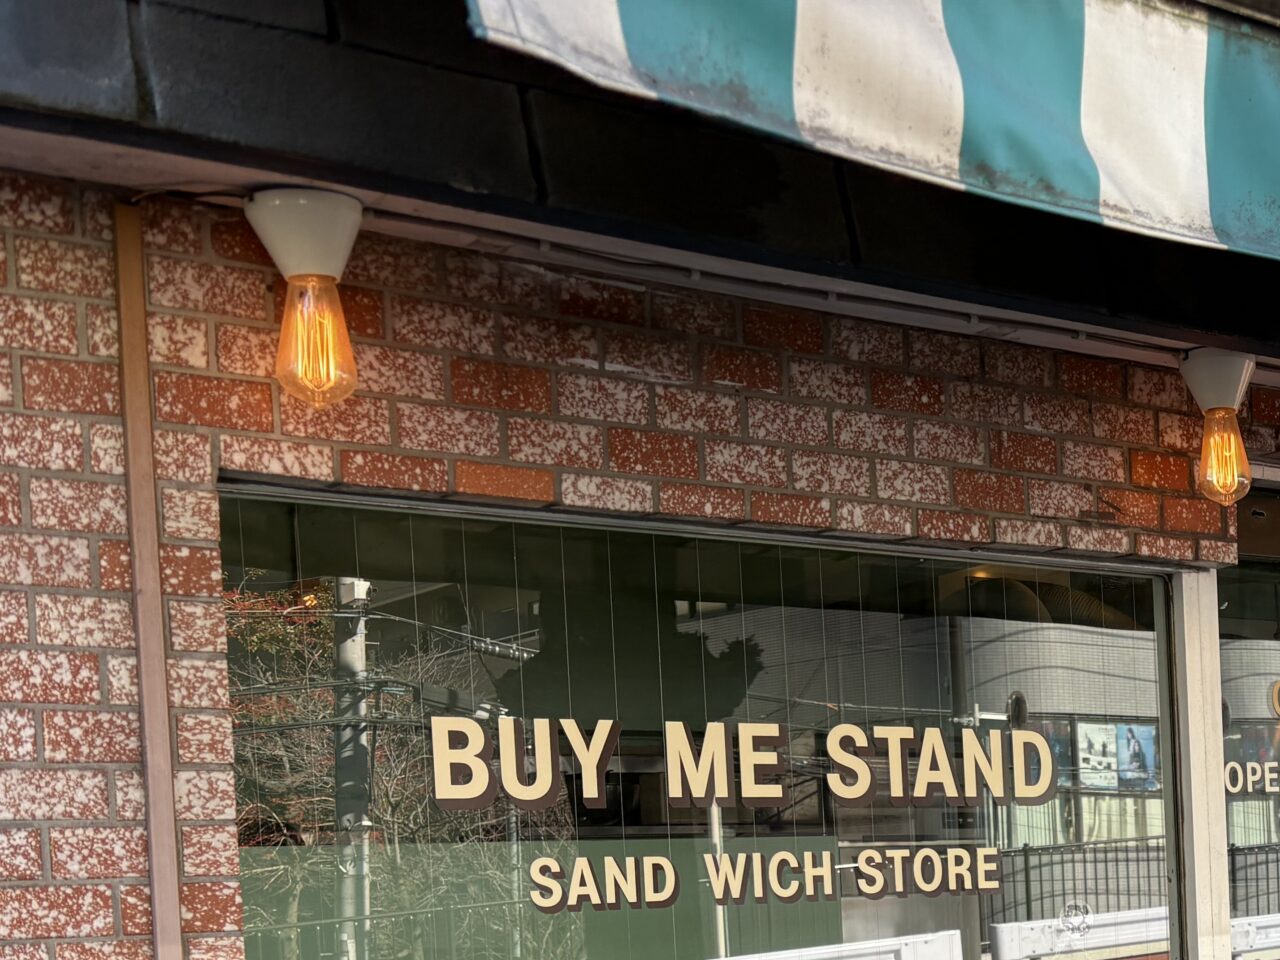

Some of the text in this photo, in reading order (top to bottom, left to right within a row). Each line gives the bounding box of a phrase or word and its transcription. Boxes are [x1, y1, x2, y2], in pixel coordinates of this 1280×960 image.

[431, 716, 1056, 808] BUY ME STAND
[530, 847, 1002, 911] SAND WICH STORE
